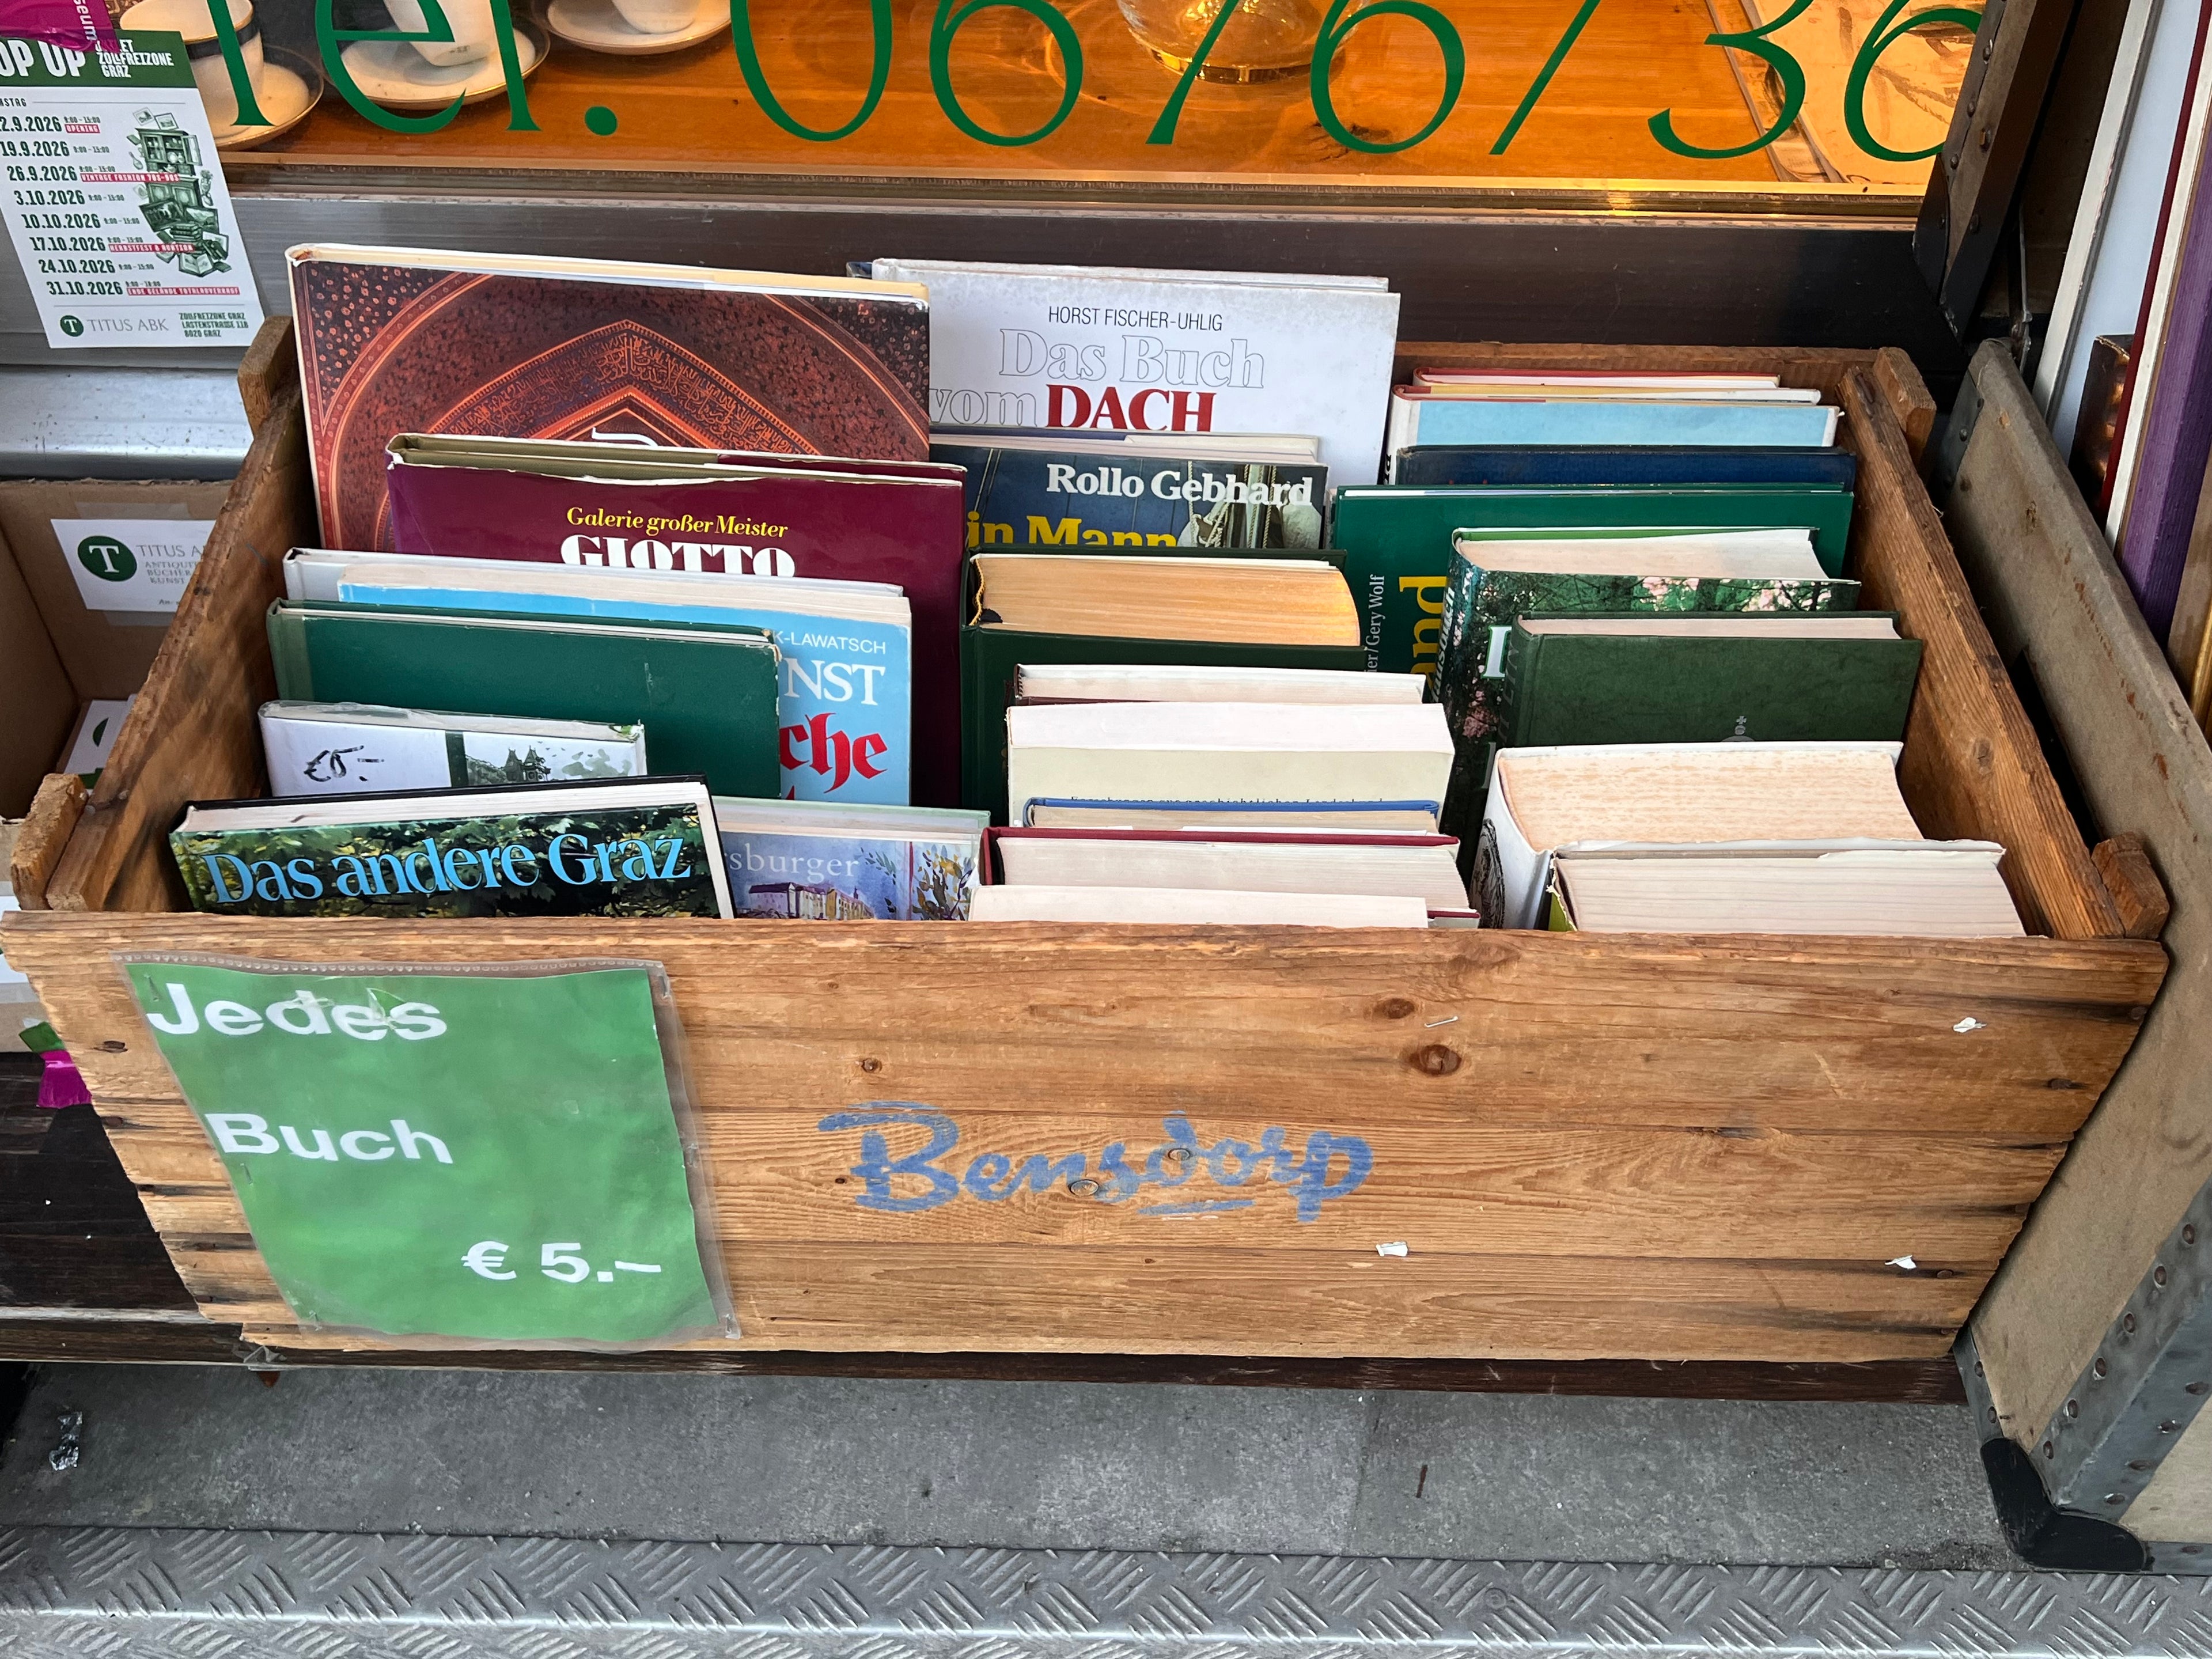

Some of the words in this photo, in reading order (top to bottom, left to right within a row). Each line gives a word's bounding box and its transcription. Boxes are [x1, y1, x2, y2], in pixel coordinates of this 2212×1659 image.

[0, 39, 34, 77] OP
[37, 40, 86, 77] UP
[101, 65, 131, 78] GRAZ
[0, 116, 62, 132] 2.9.2026
[0, 141, 70, 157] 19.9.2026
[7, 166, 78, 181] 26.9.2026
[14, 190, 85, 205] 3.10.2026
[21, 214, 101, 228] 10.10.2026
[29, 237, 105, 251] 17.10.2026
[39, 259, 115, 273] 24.10.2026
[47, 281, 123, 295] 31.10.2026
[87, 319, 132, 332] TITUS
[138, 319, 169, 331] ABK
[1048, 306, 1100, 326] HORST
[1105, 309, 1223, 332] FISCHER-UHLIG
[998, 328, 1107, 381] Das
[1120, 335, 1264, 389] Buch
[929, 388, 1037, 427] vom
[1046, 384, 1217, 432] DACH
[1046, 463, 1145, 498] Rollo
[1152, 470, 1313, 507] Gebhard
[567, 507, 644, 528] Galerie
[646, 514, 714, 536] großer
[714, 514, 788, 538] Meister
[967, 511, 1014, 547] in
[1027, 515, 1177, 548] Mann
[136, 545, 185, 558] TITUS
[560, 534, 796, 577] GIOTTO
[1368, 574, 1385, 609] Wolf
[775, 630, 886, 655] K-LAWATSCH
[1365, 611, 1385, 646] Gery
[1364, 654, 1378, 672] ier
[783, 658, 885, 706] NST
[779, 713, 888, 793] che
[201, 853, 324, 903] Das
[331, 837, 539, 897] andere
[548, 833, 691, 885] Graz
[724, 842, 859, 884] sburger
[147, 982, 447, 1041] Jedes
[205, 1113, 453, 1164] Buch
[817, 1100, 1376, 1224] Bensdorp
